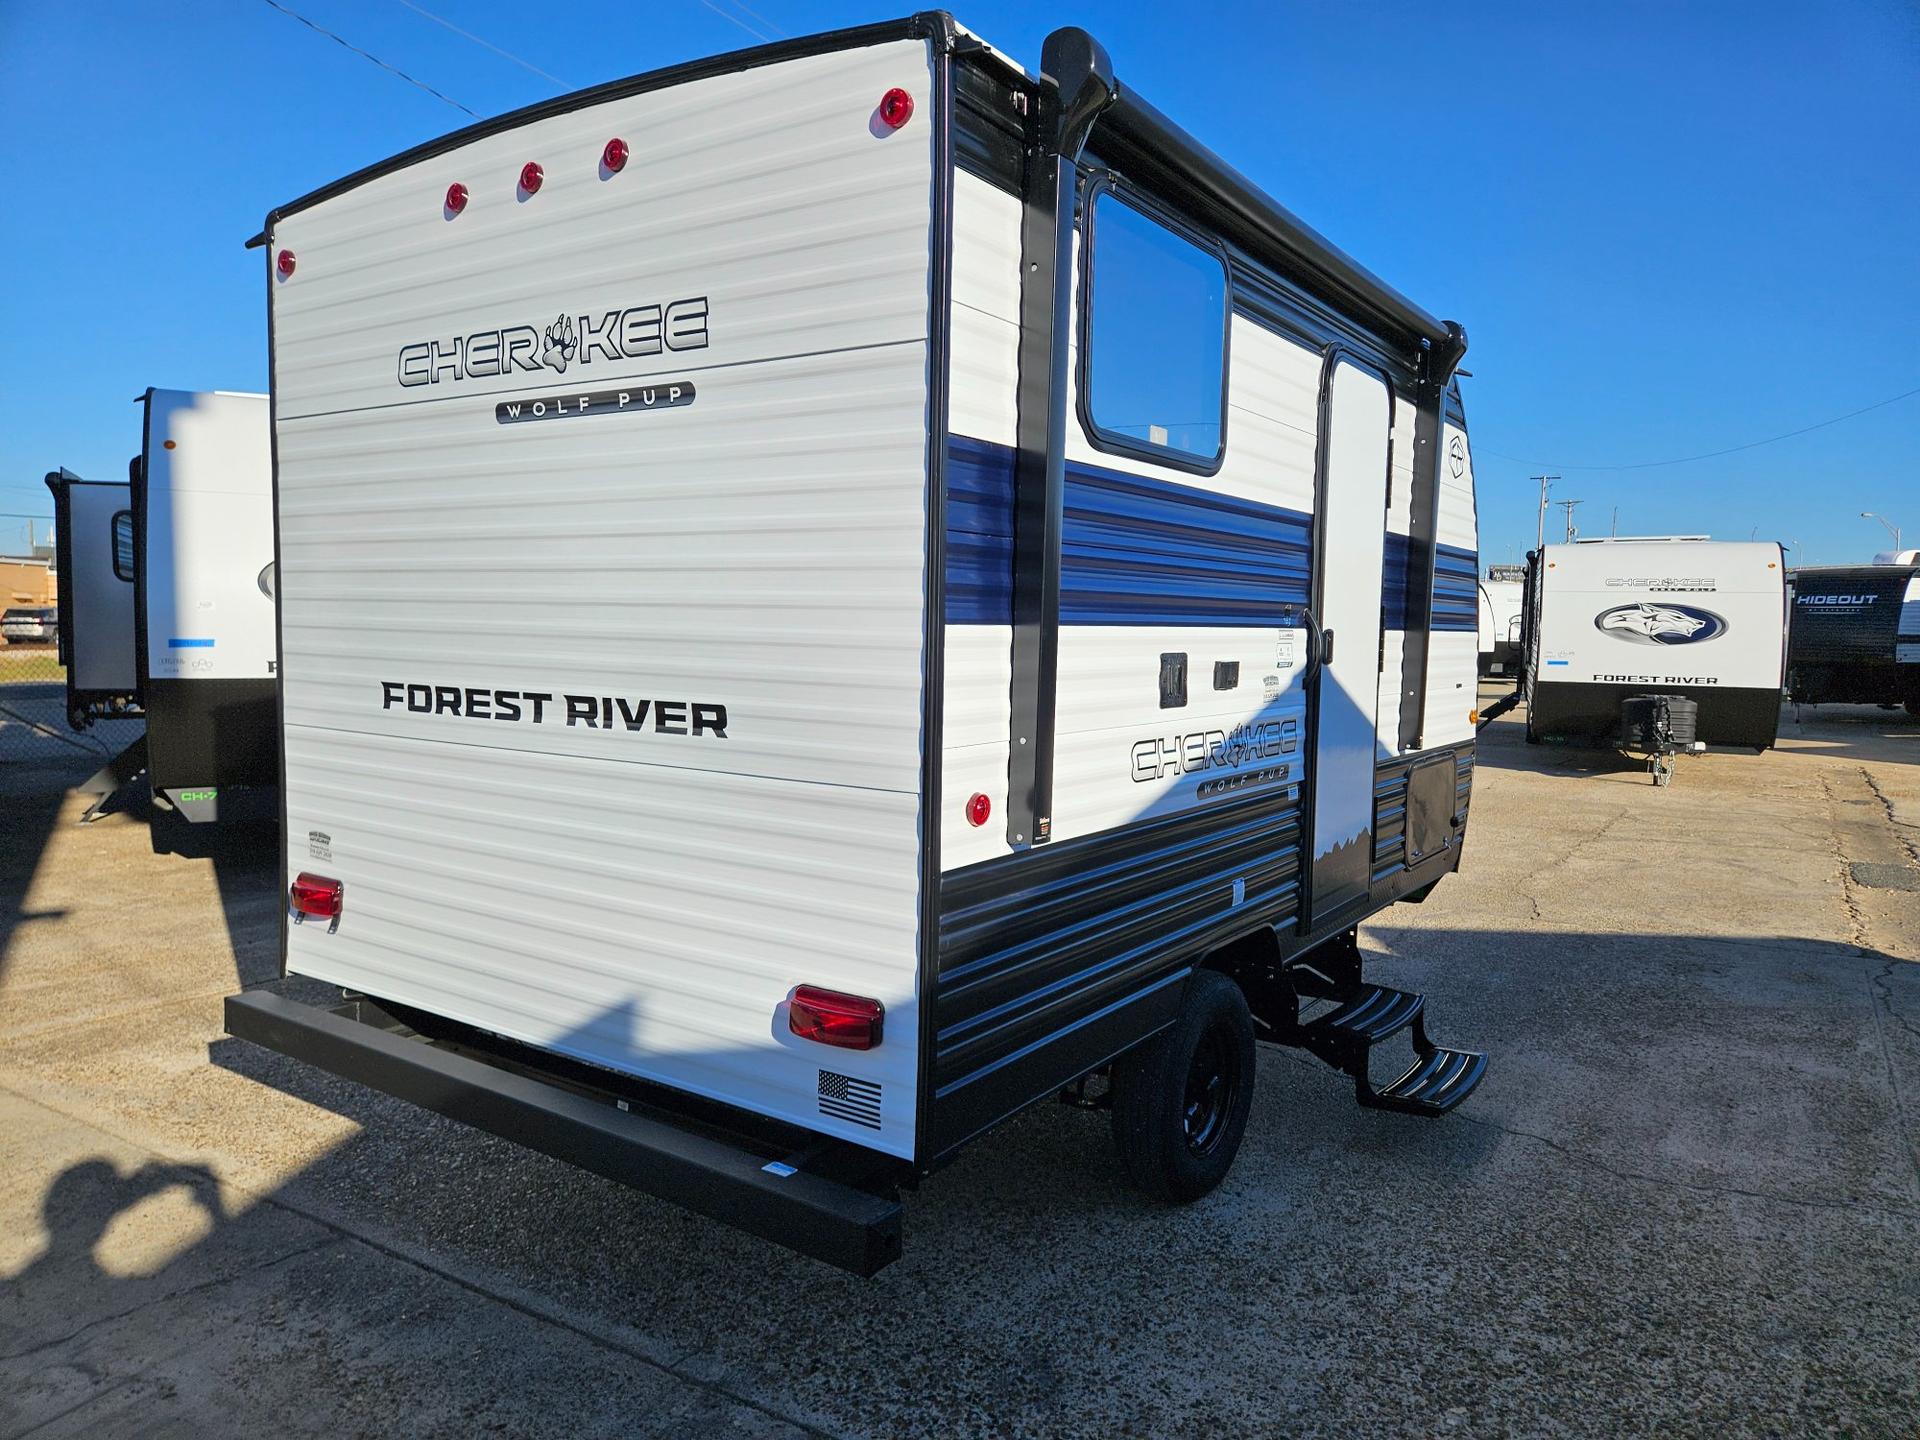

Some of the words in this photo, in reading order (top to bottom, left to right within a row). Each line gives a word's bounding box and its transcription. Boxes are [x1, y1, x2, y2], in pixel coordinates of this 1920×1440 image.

[506, 397, 589, 419] WOLF
[618, 386, 682, 408] PUP
[1797, 594, 1878, 604] HIDEOUT
[1592, 674, 1661, 683] FOREST
[1664, 676, 1718, 685] RIVER
[380, 681, 553, 724] FOREST
[563, 694, 729, 739] RIVER
[1203, 775, 1248, 794] WOLF
[1258, 766, 1286, 783] PUP
